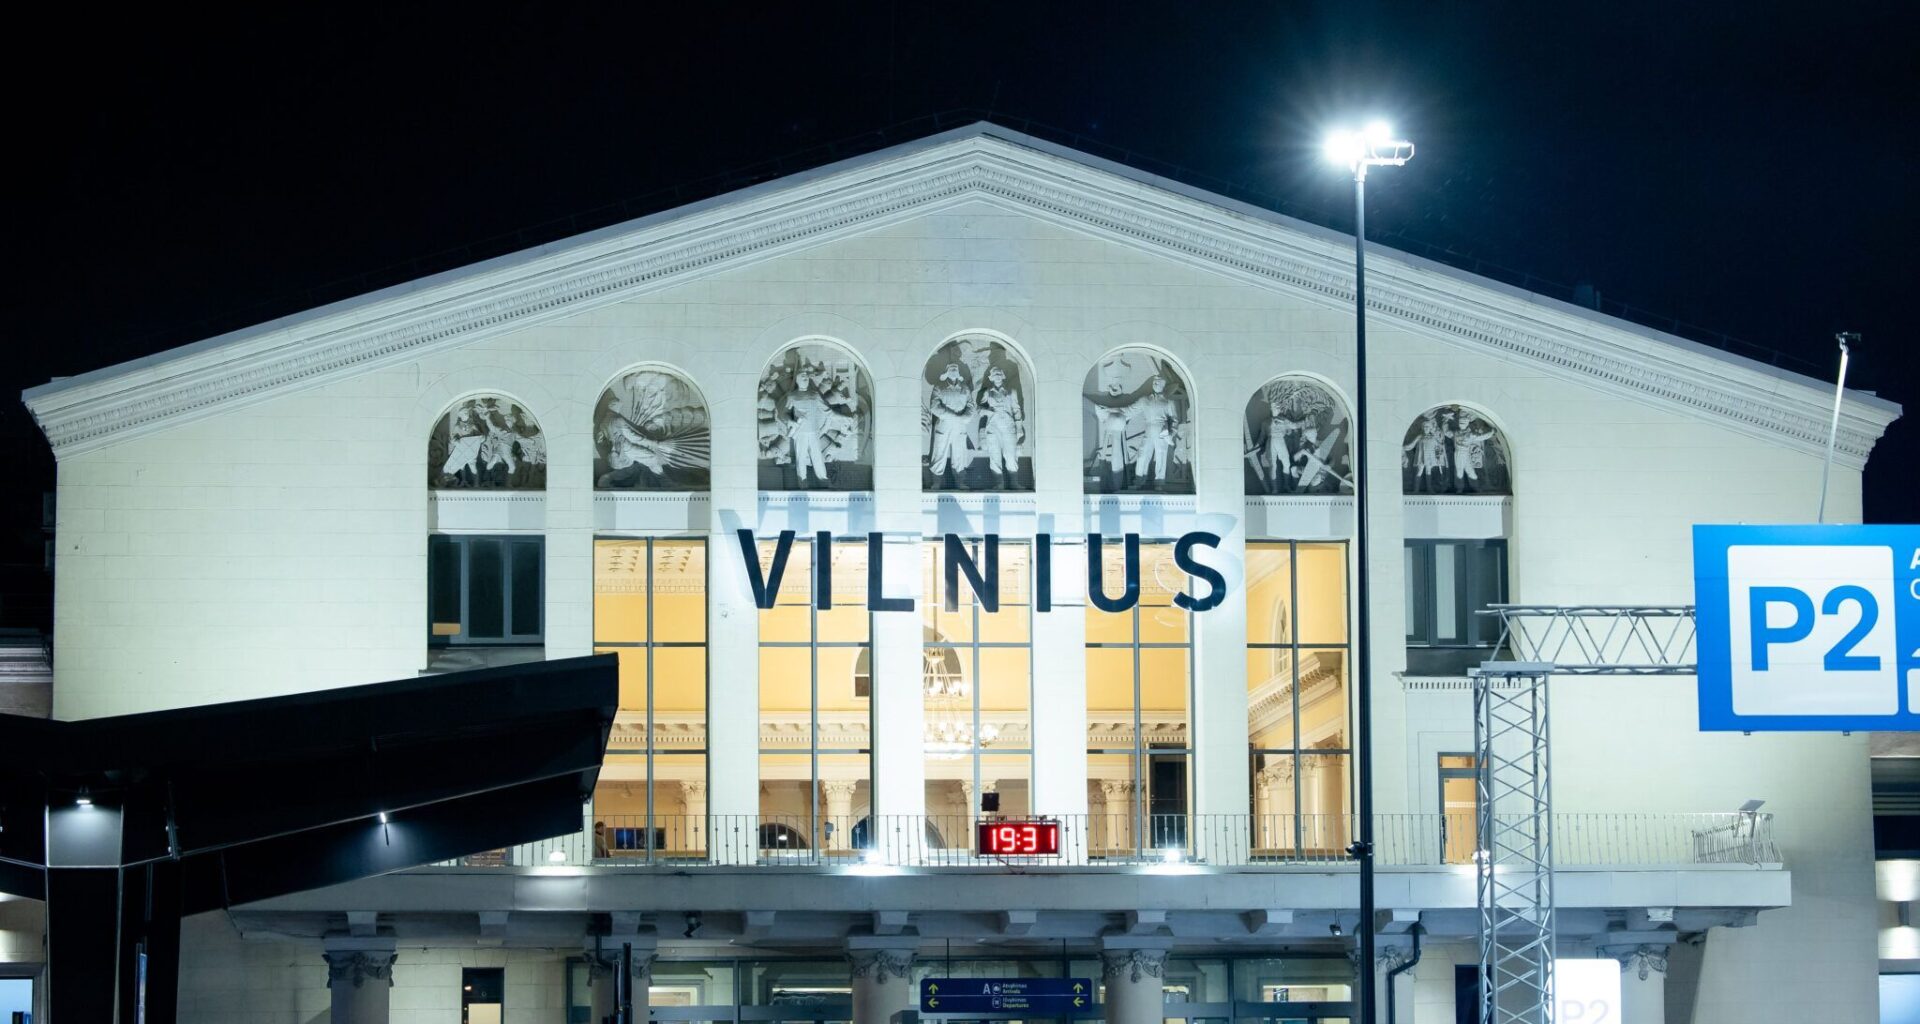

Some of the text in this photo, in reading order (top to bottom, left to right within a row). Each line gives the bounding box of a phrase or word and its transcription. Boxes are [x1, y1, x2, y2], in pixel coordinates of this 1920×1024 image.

[736, 528, 1227, 613] VILNIUS
[1749, 585, 1881, 671] P2
[991, 827, 1056, 852] 19:31
[983, 983, 991, 994] A
[1561, 998, 1609, 1024] P2
